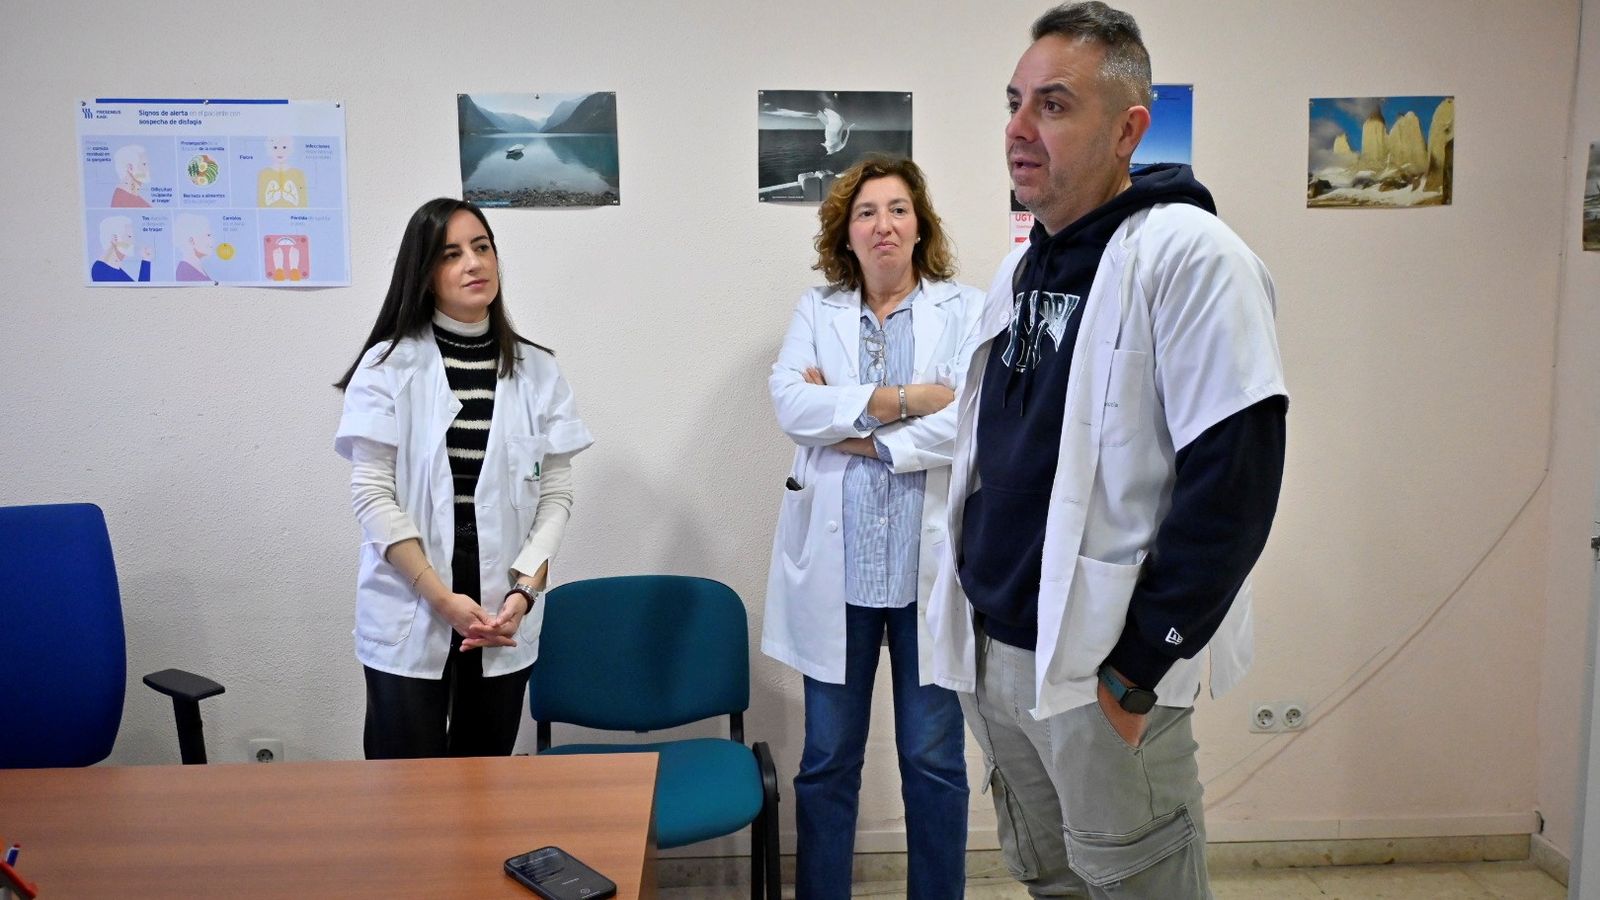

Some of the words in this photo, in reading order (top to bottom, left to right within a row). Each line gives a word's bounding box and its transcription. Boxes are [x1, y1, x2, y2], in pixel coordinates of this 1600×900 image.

[138, 109, 159, 117] Signos
[178, 118, 203, 126] disfagia
[1015, 213, 1032, 222] UGT
